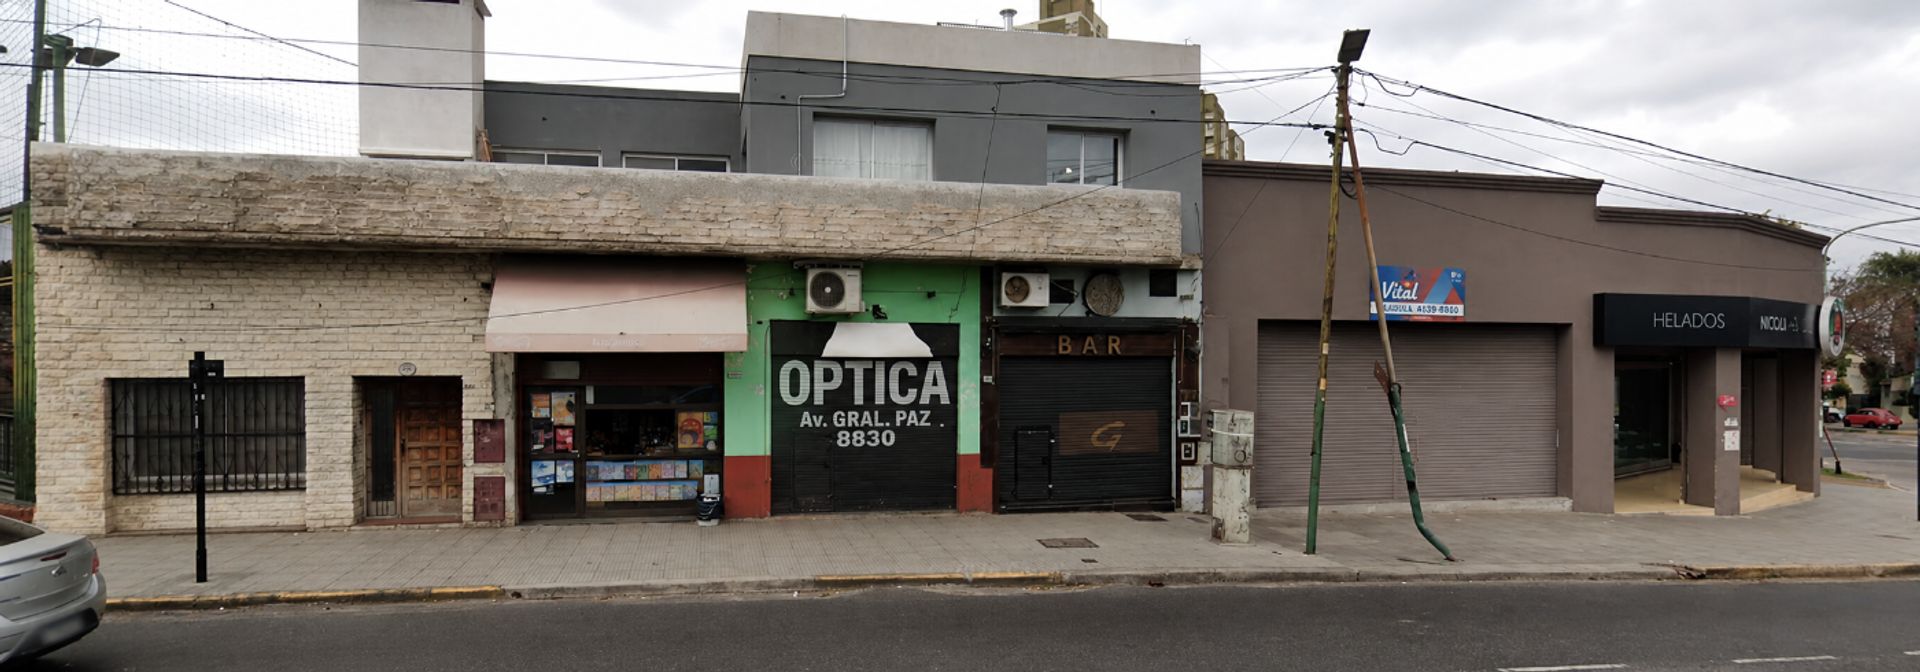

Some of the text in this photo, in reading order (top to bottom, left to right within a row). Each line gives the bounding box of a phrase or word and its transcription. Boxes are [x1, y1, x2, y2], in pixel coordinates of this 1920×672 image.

[1382, 281, 1419, 300] Vital
[1653, 312, 1725, 329] HELADOS
[1058, 335, 1122, 355] BAR
[779, 359, 951, 406] OPTICA
[799, 410, 932, 428] Av. GRAL. PAZ
[836, 430, 896, 447] 8830
